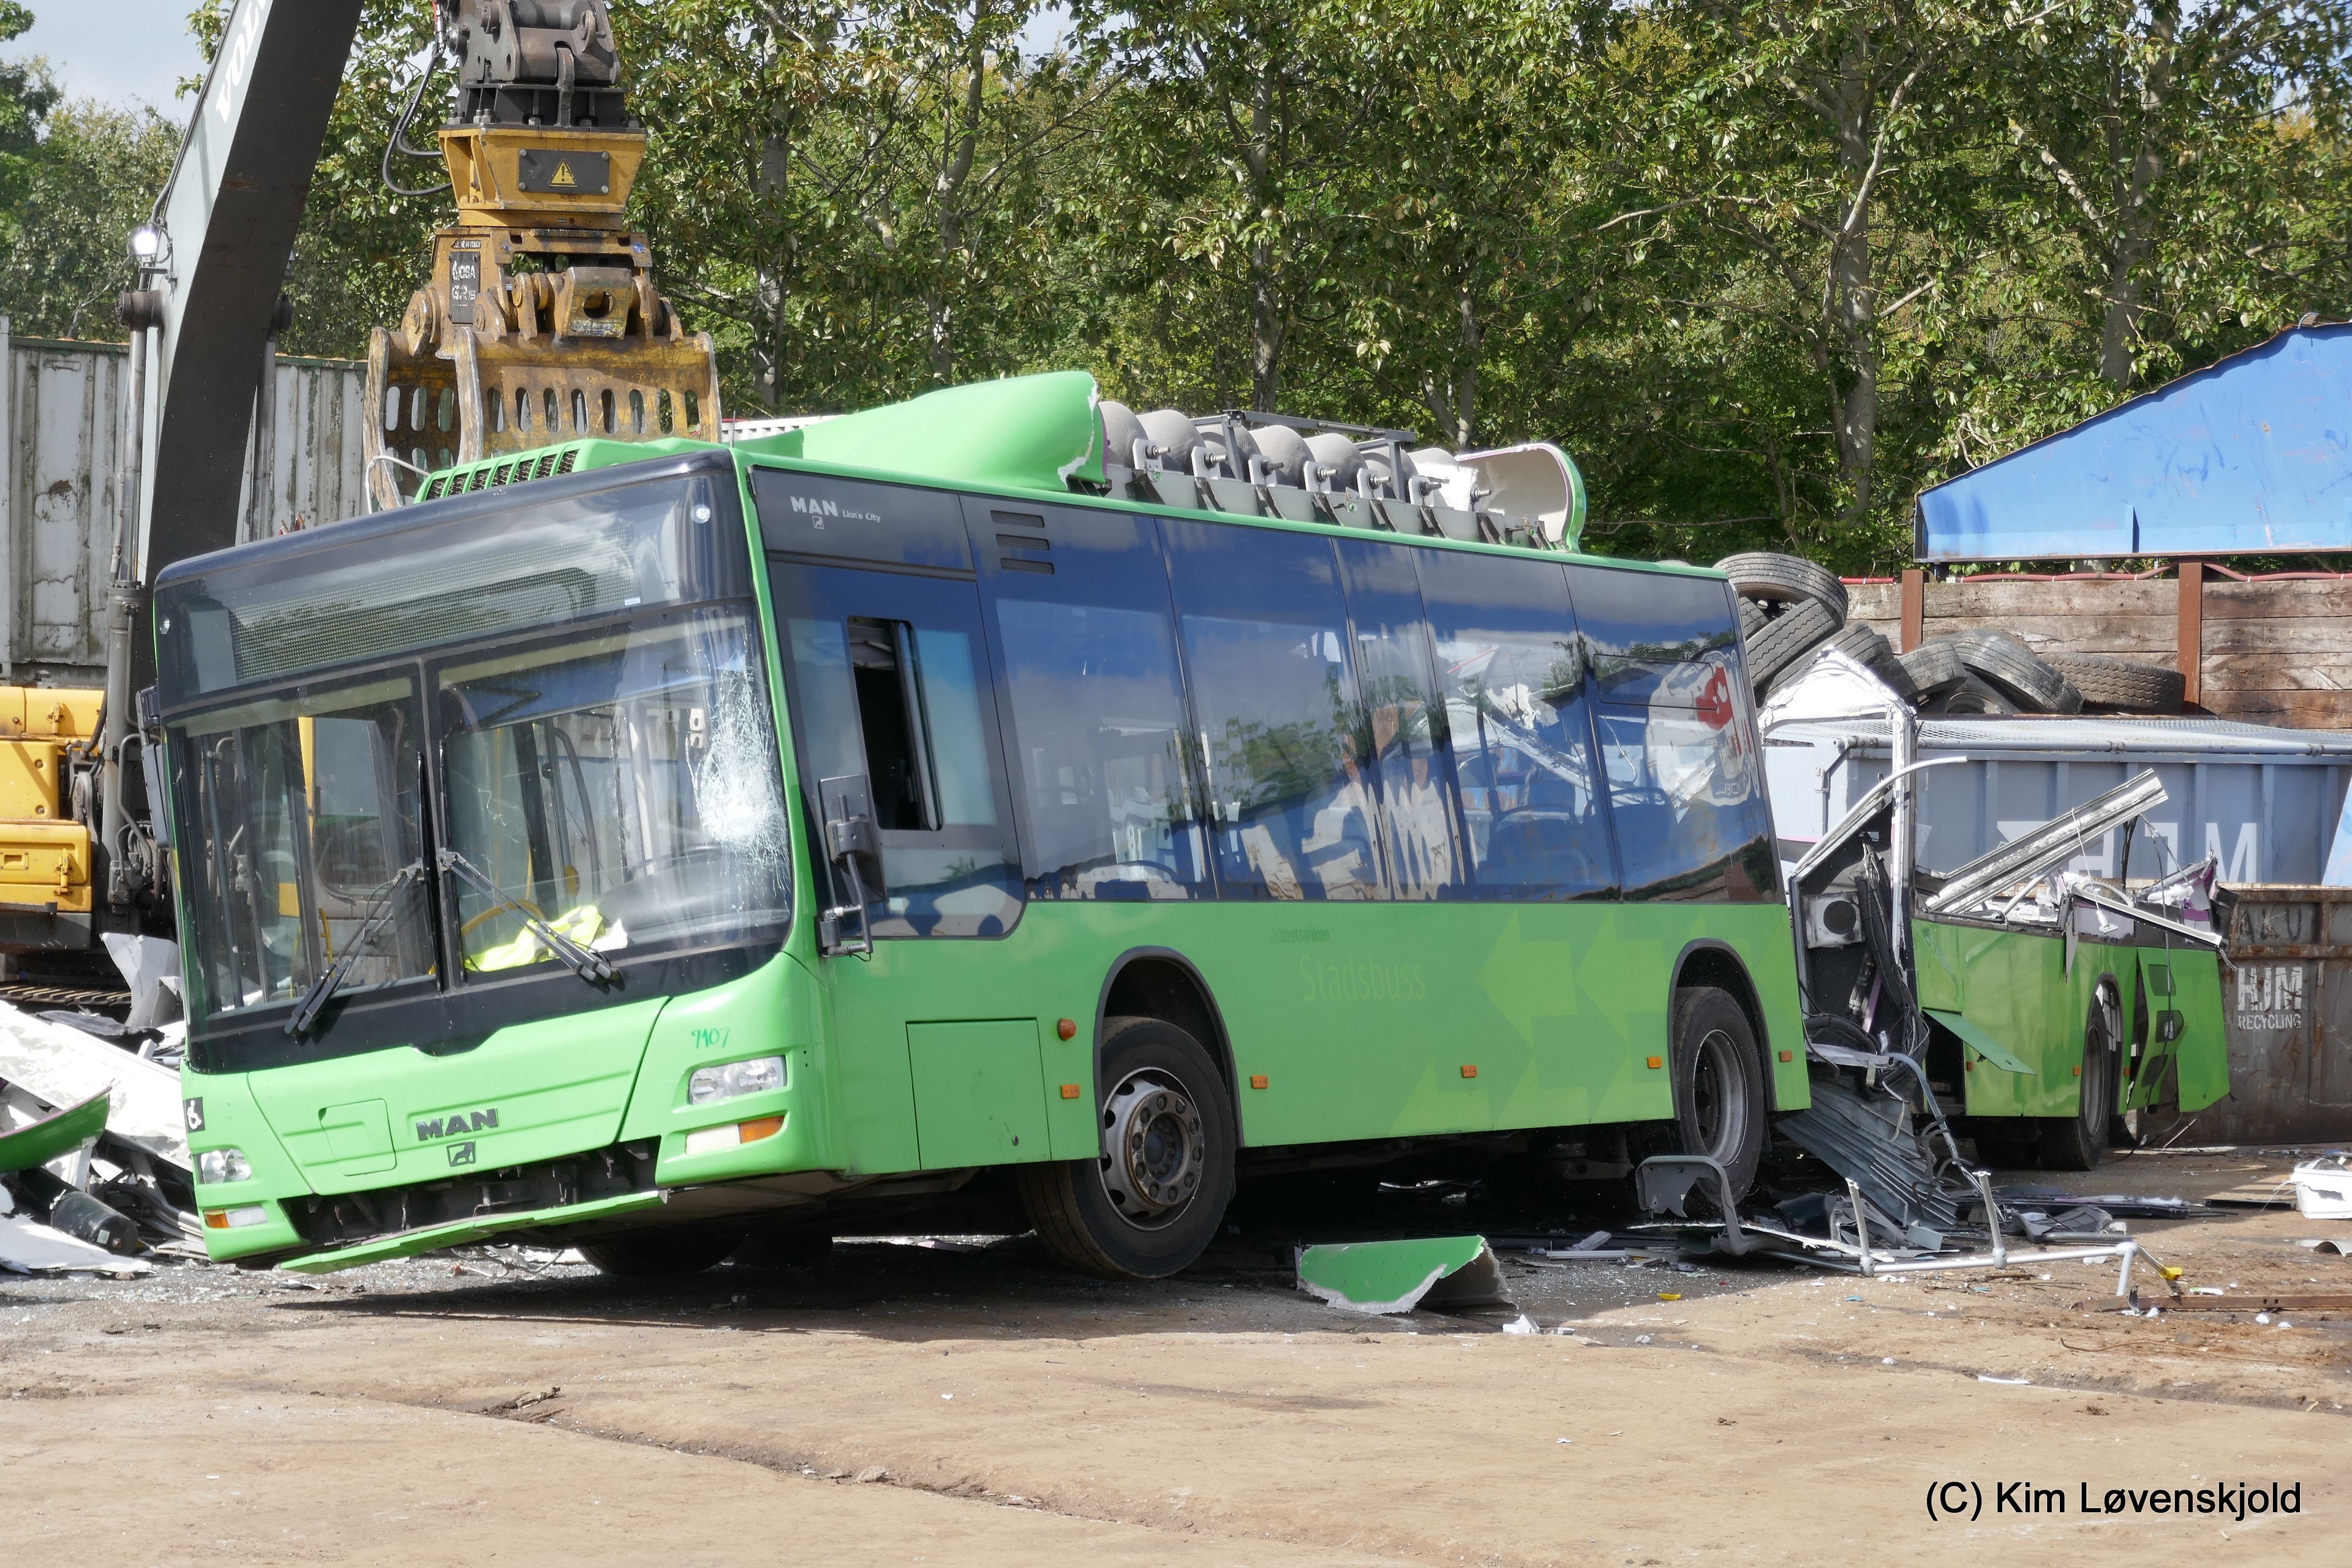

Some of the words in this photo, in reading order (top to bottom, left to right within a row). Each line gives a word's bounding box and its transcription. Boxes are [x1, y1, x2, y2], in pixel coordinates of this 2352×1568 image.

[216, 0, 268, 123] VOL
[790, 496, 838, 517] MAN
[842, 510, 863, 519] Lion's
[865, 512, 881, 523] City
[1299, 951, 1426, 1003] Stadsbuss
[2237, 966, 2303, 1011] HJM
[691, 1028, 730, 1049] 7107
[2237, 1014, 2301, 1030] RECYCLING
[415, 1107, 499, 1141] MAN
